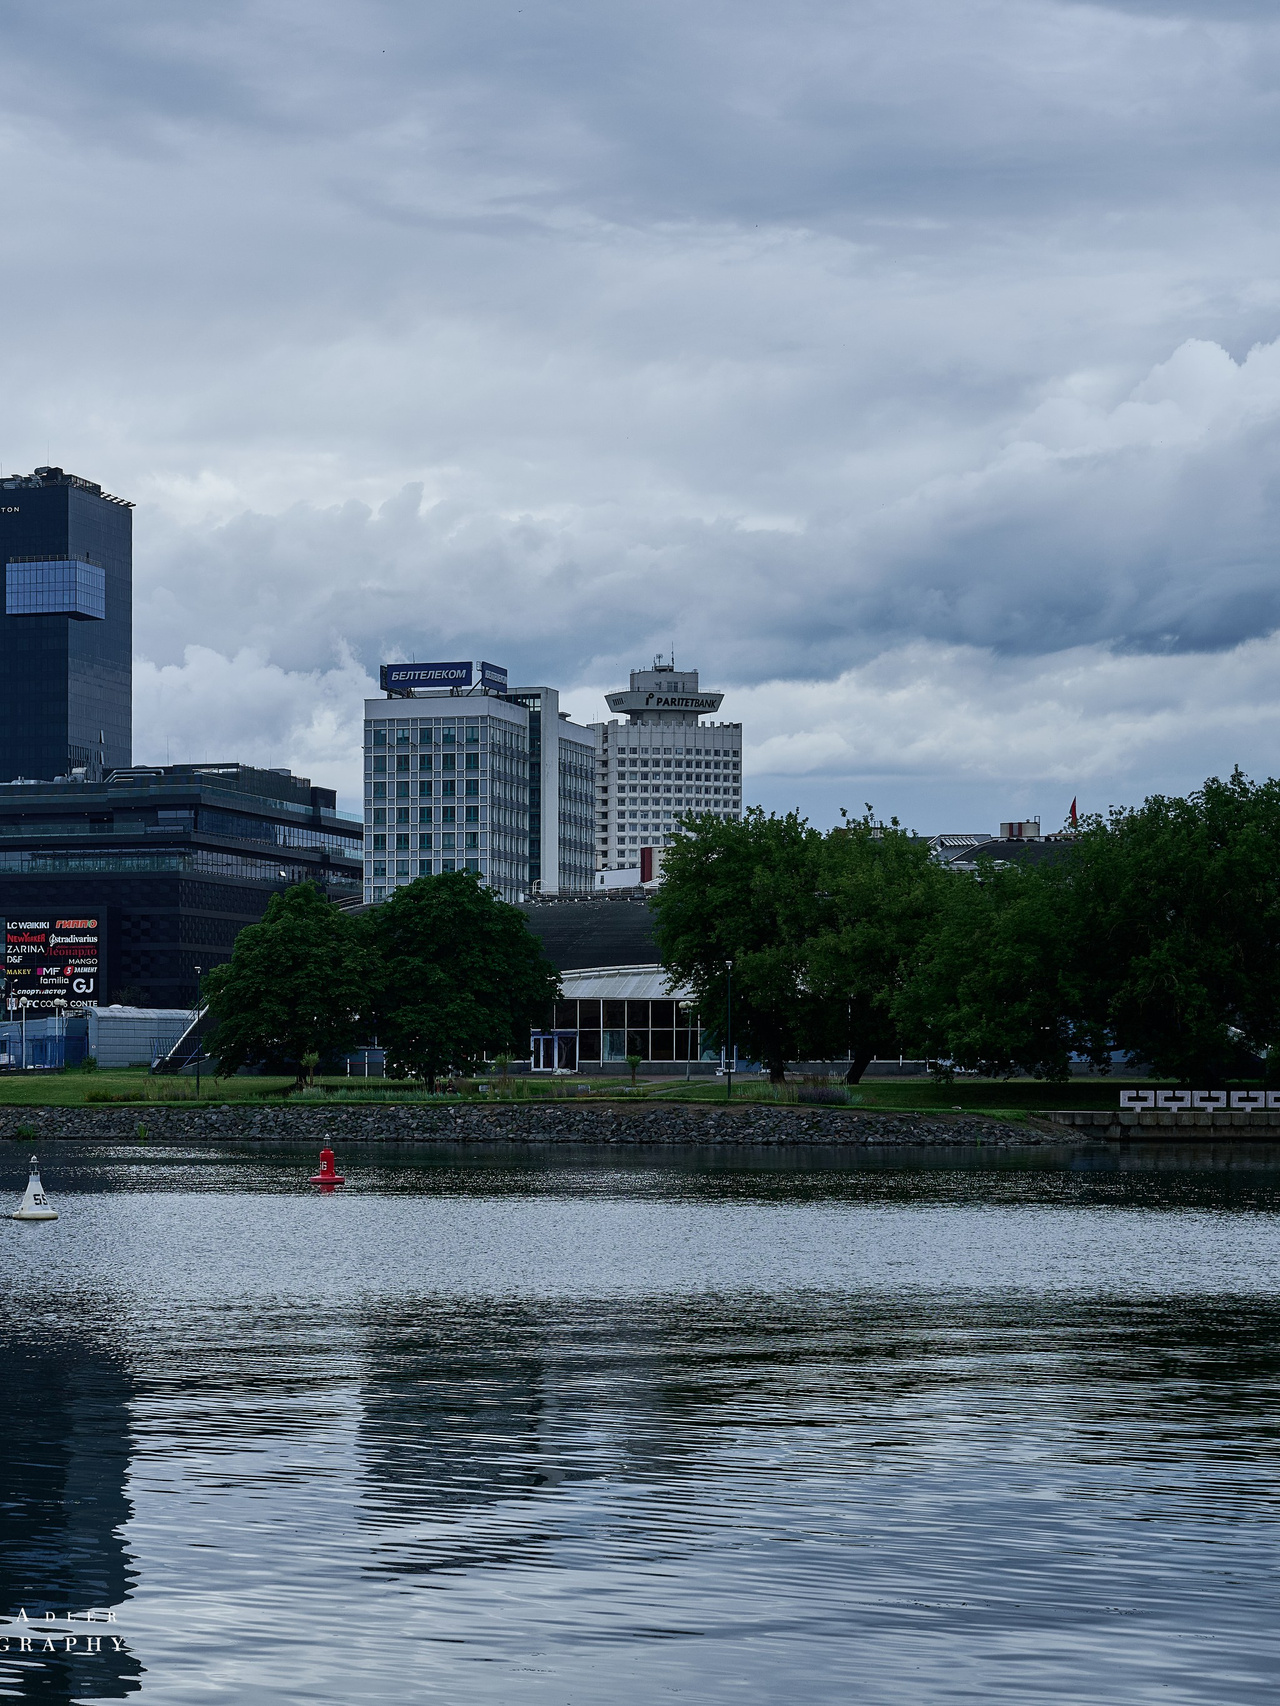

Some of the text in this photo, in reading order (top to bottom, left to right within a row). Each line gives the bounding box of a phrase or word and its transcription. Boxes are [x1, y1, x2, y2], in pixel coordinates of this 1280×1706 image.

[391, 669, 467, 681] БЕЛТЕЛЕКОМ
[6, 921, 18, 930] LC
[6, 945, 46, 954] ZARINA
[6, 955, 24, 964] D&F
[6, 968, 32, 976] MAKEY
[40, 976, 70, 985] familia
[72, 977, 95, 994] GJ
[69, 1000, 98, 1008] CONTE
